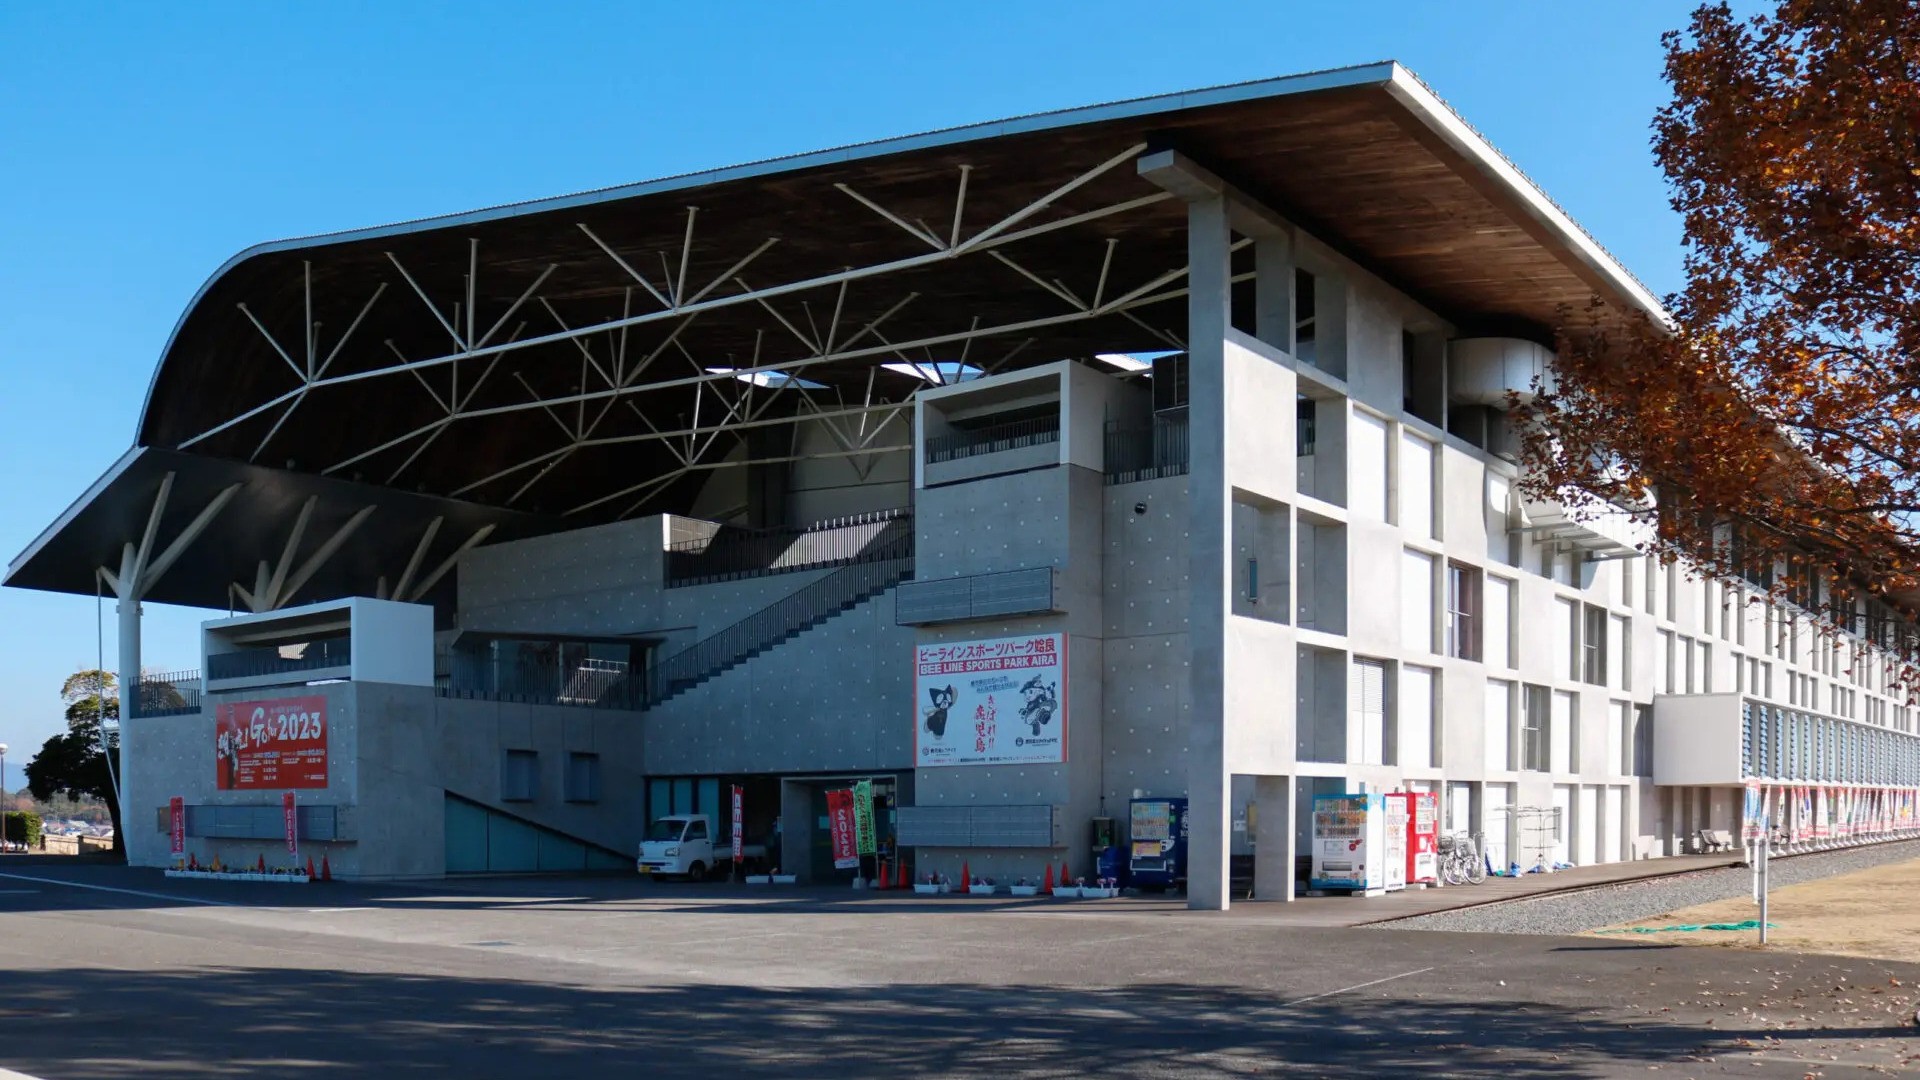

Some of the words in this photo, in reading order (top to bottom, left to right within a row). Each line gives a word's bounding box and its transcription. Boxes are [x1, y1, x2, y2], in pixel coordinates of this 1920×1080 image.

[920, 663, 942, 675] BEE
[943, 661, 963, 673] LINE
[966, 658, 1002, 671] SPORTS
[1004, 656, 1029, 668] PARK
[1030, 653, 1055, 667] AIRA
[277, 712, 322, 741] 2023
[974, 704, 986, 753] 鹿児島
